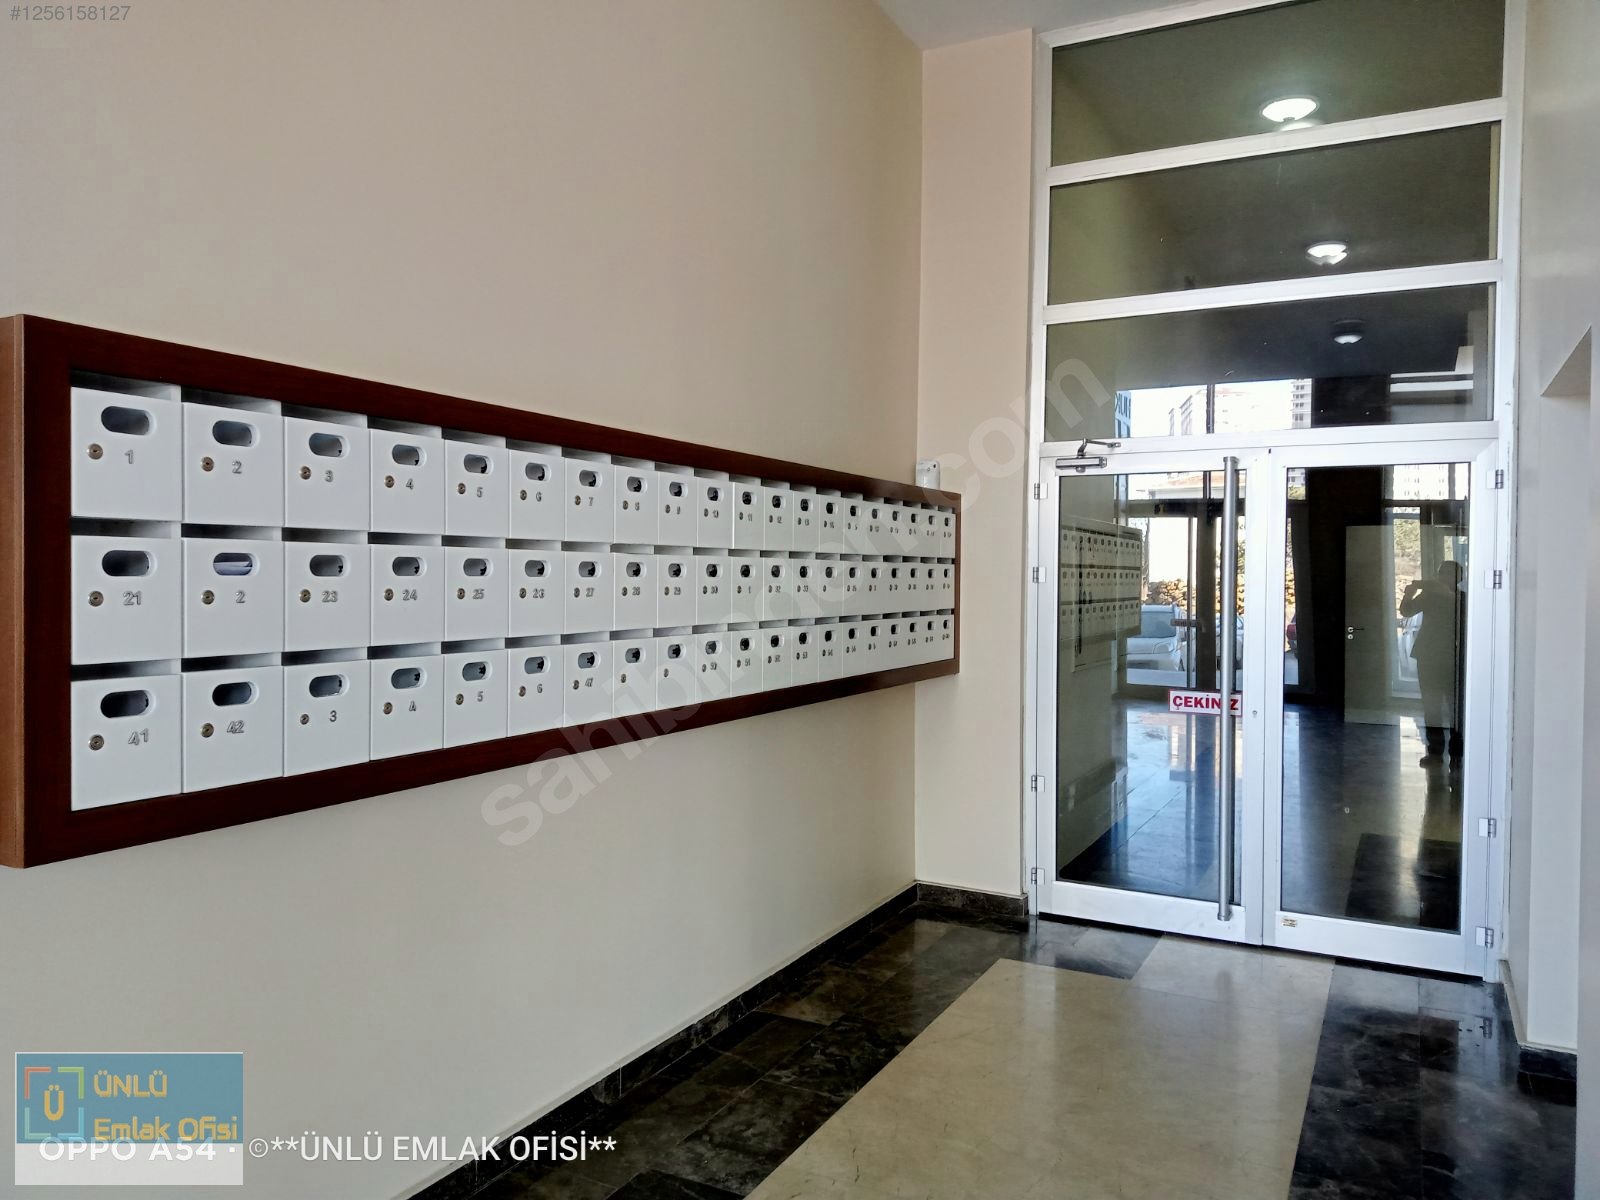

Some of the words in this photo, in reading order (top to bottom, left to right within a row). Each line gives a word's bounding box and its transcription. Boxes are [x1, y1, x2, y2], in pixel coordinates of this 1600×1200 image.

[124, 449, 135, 465] 1
[231, 460, 243, 475] 2
[324, 469, 334, 483] 3
[405, 478, 415, 491] 4
[476, 486, 484, 498] 5
[123, 590, 143, 606] 21
[235, 589, 247, 604] 2
[321, 590, 339, 603] 23
[402, 589, 419, 602] 24
[472, 589, 485, 600] 25
[536, 684, 544, 694] 6
[476, 691, 485, 702] 5
[1172, 694, 1239, 711] ÇEKİNZ
[328, 709, 338, 723] 3
[226, 719, 246, 734] 42
[127, 728, 150, 746] 41
